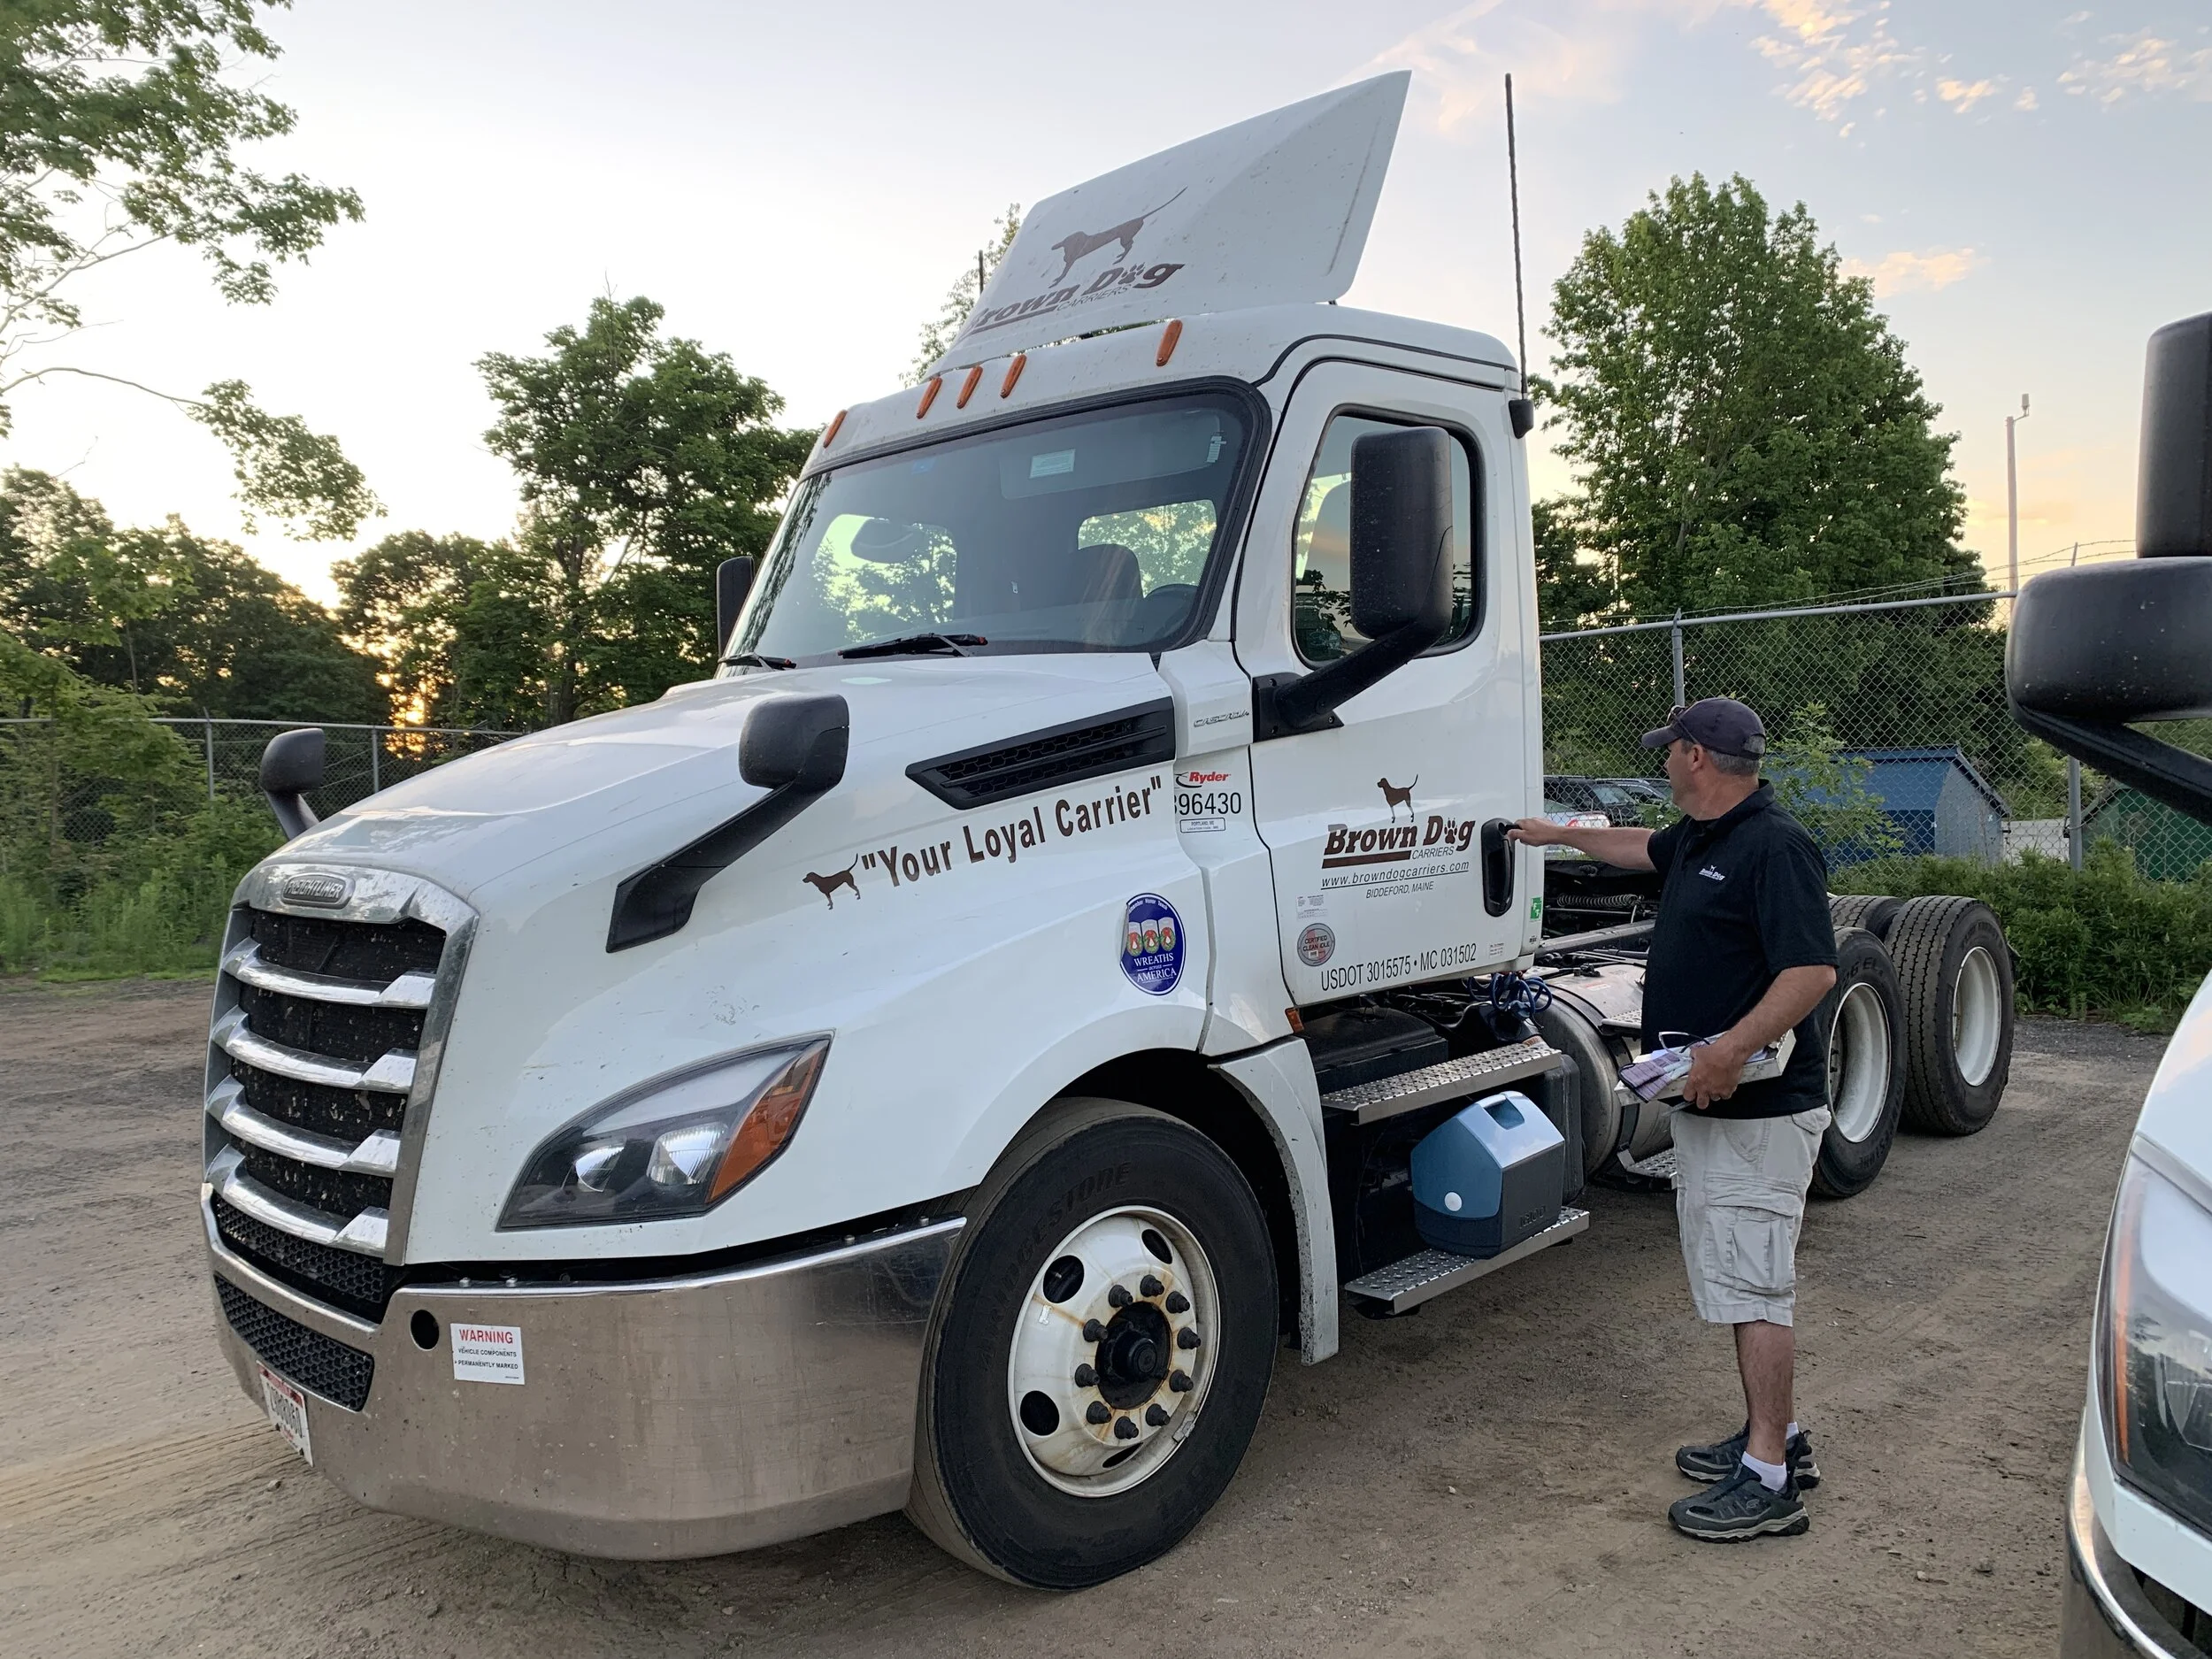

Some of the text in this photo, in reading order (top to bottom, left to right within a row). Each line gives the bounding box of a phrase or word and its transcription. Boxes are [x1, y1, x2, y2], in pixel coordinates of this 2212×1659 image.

[1056, 284, 1133, 311] CARRIERS
[1189, 772, 1229, 784] Ryder
[862, 776, 1162, 887] "Your Loyal Carrier"
[1324, 823, 1417, 856] Brown
[1411, 846, 1454, 860] CARRIERS
[1322, 861, 1470, 887] www.browndogcarriers.com
[1366, 881, 1434, 899] BIDDEFORD, MAINE
[1133, 952, 1174, 966] WREATHS
[1321, 964, 1363, 991] USDOT
[1366, 956, 1411, 982] 3015575
[1420, 949, 1438, 972] MC
[1440, 942, 1477, 967] 031502
[1137, 967, 1177, 982] AMERICA
[459, 1329, 513, 1344] WARNING
